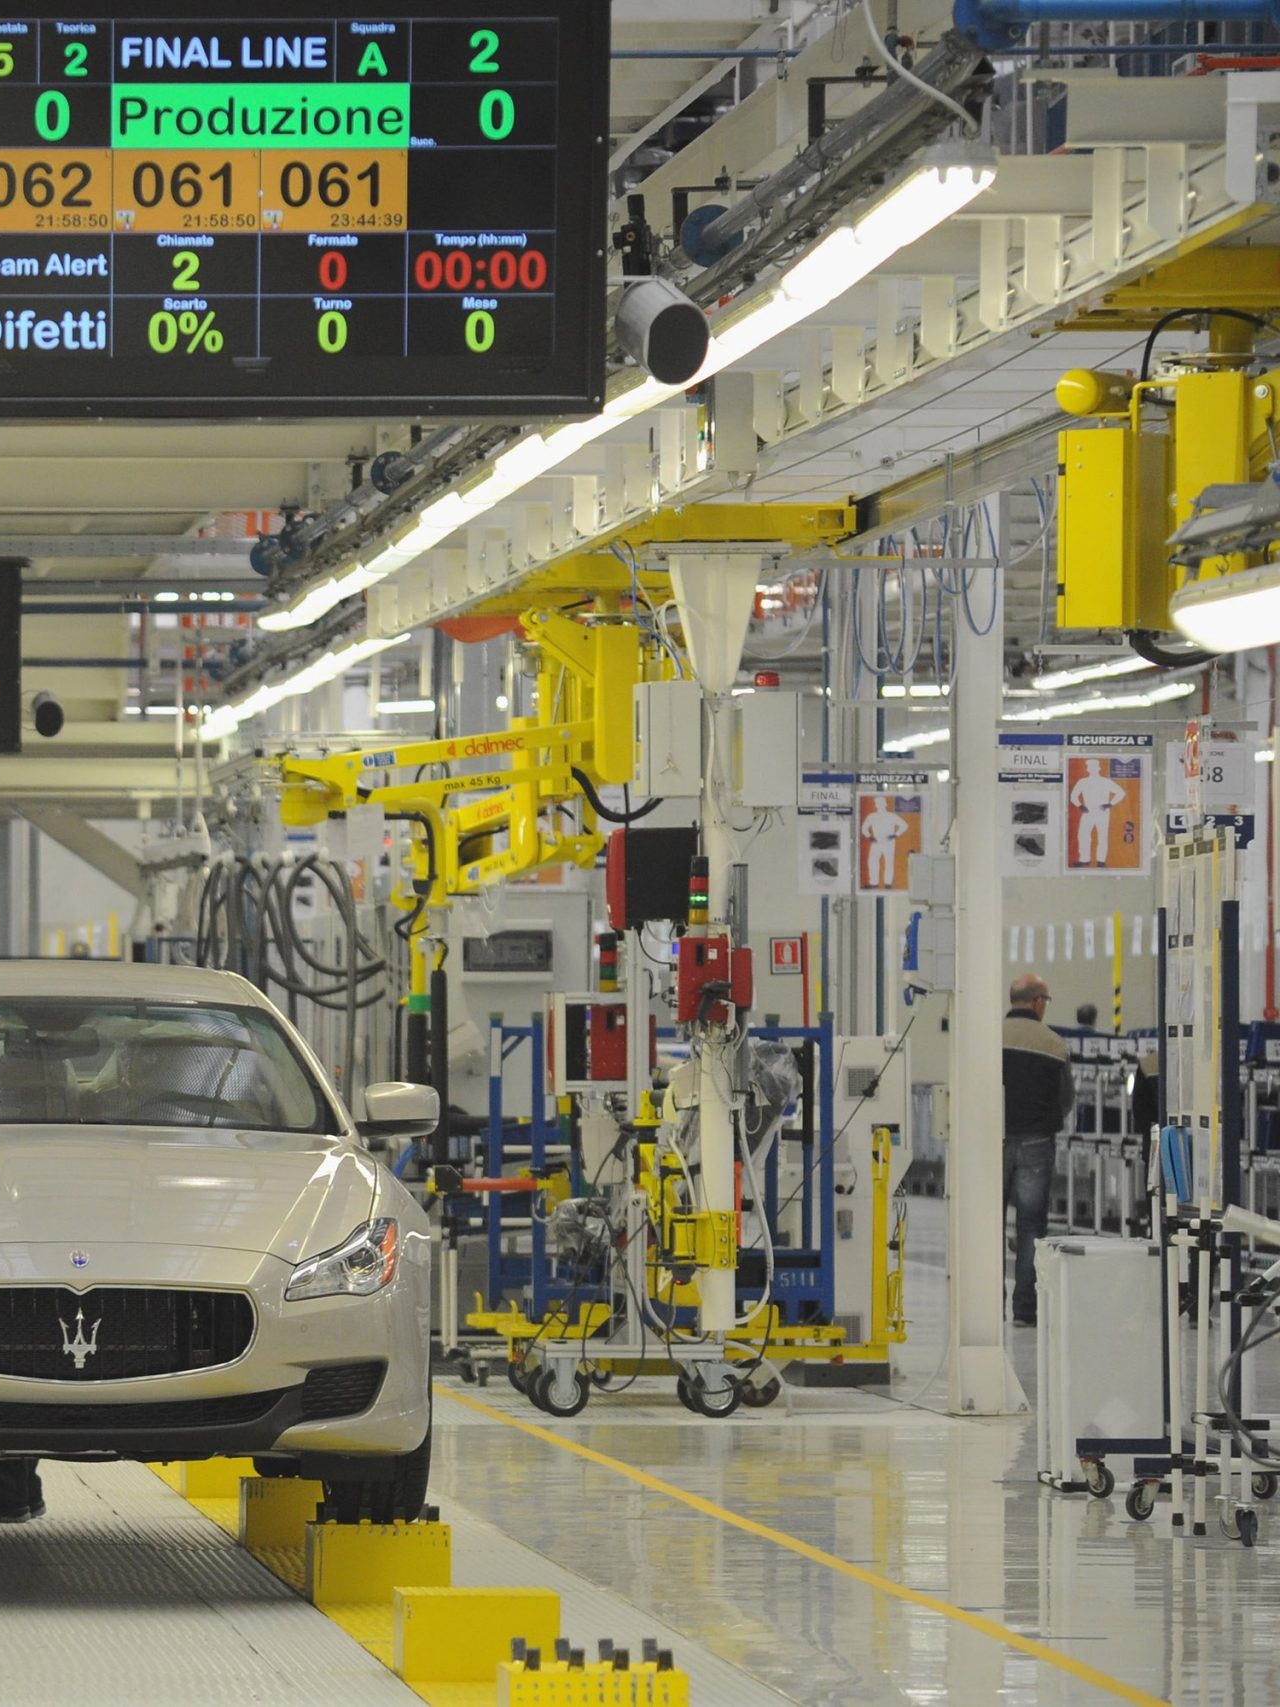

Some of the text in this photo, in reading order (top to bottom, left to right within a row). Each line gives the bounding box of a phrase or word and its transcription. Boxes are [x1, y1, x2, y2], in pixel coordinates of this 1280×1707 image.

[56, 22, 96, 34] Teorica
[350, 22, 396, 35] Squadra
[64, 42, 89, 76] 2
[121, 36, 327, 69] FINAL LINE
[357, 41, 388, 77] A
[469, 29, 500, 73] 2
[34, 90, 70, 141] 0
[119, 95, 404, 136] Produzione
[479, 89, 515, 140] 0
[410, 136, 437, 148] Succ.
[132, 161, 232, 208] 061
[280, 161, 380, 208] 061
[35, 214, 108, 228] 21:58:50
[183, 214, 256, 228] 21:58:50
[330, 213, 403, 228] 23:44:39
[156, 234, 214, 247] Chiamate
[308, 233, 358, 247] Fermate
[435, 233, 528, 248] Tempo (hh:mm)
[44, 253, 108, 277] Alert
[172, 251, 200, 291] 2
[318, 250, 348, 291] 0
[414, 250, 547, 291] 00:00
[163, 298, 207, 311] Scarto
[313, 297, 352, 310] Turno
[462, 297, 497, 310] Mese
[148, 310, 224, 354] 0%
[317, 310, 348, 353] 0
[464, 310, 495, 353] 0
[464, 735, 525, 757] dalmec
[1072, 736, 1135, 745] SICUREZZA
[1013, 755, 1048, 766] FINAL
[444, 776, 501, 792] max 45 Kg
[860, 774, 914, 783] SICUREZZA
[811, 791, 840, 800] FINAL
[1234, 816, 1244, 826] 3
